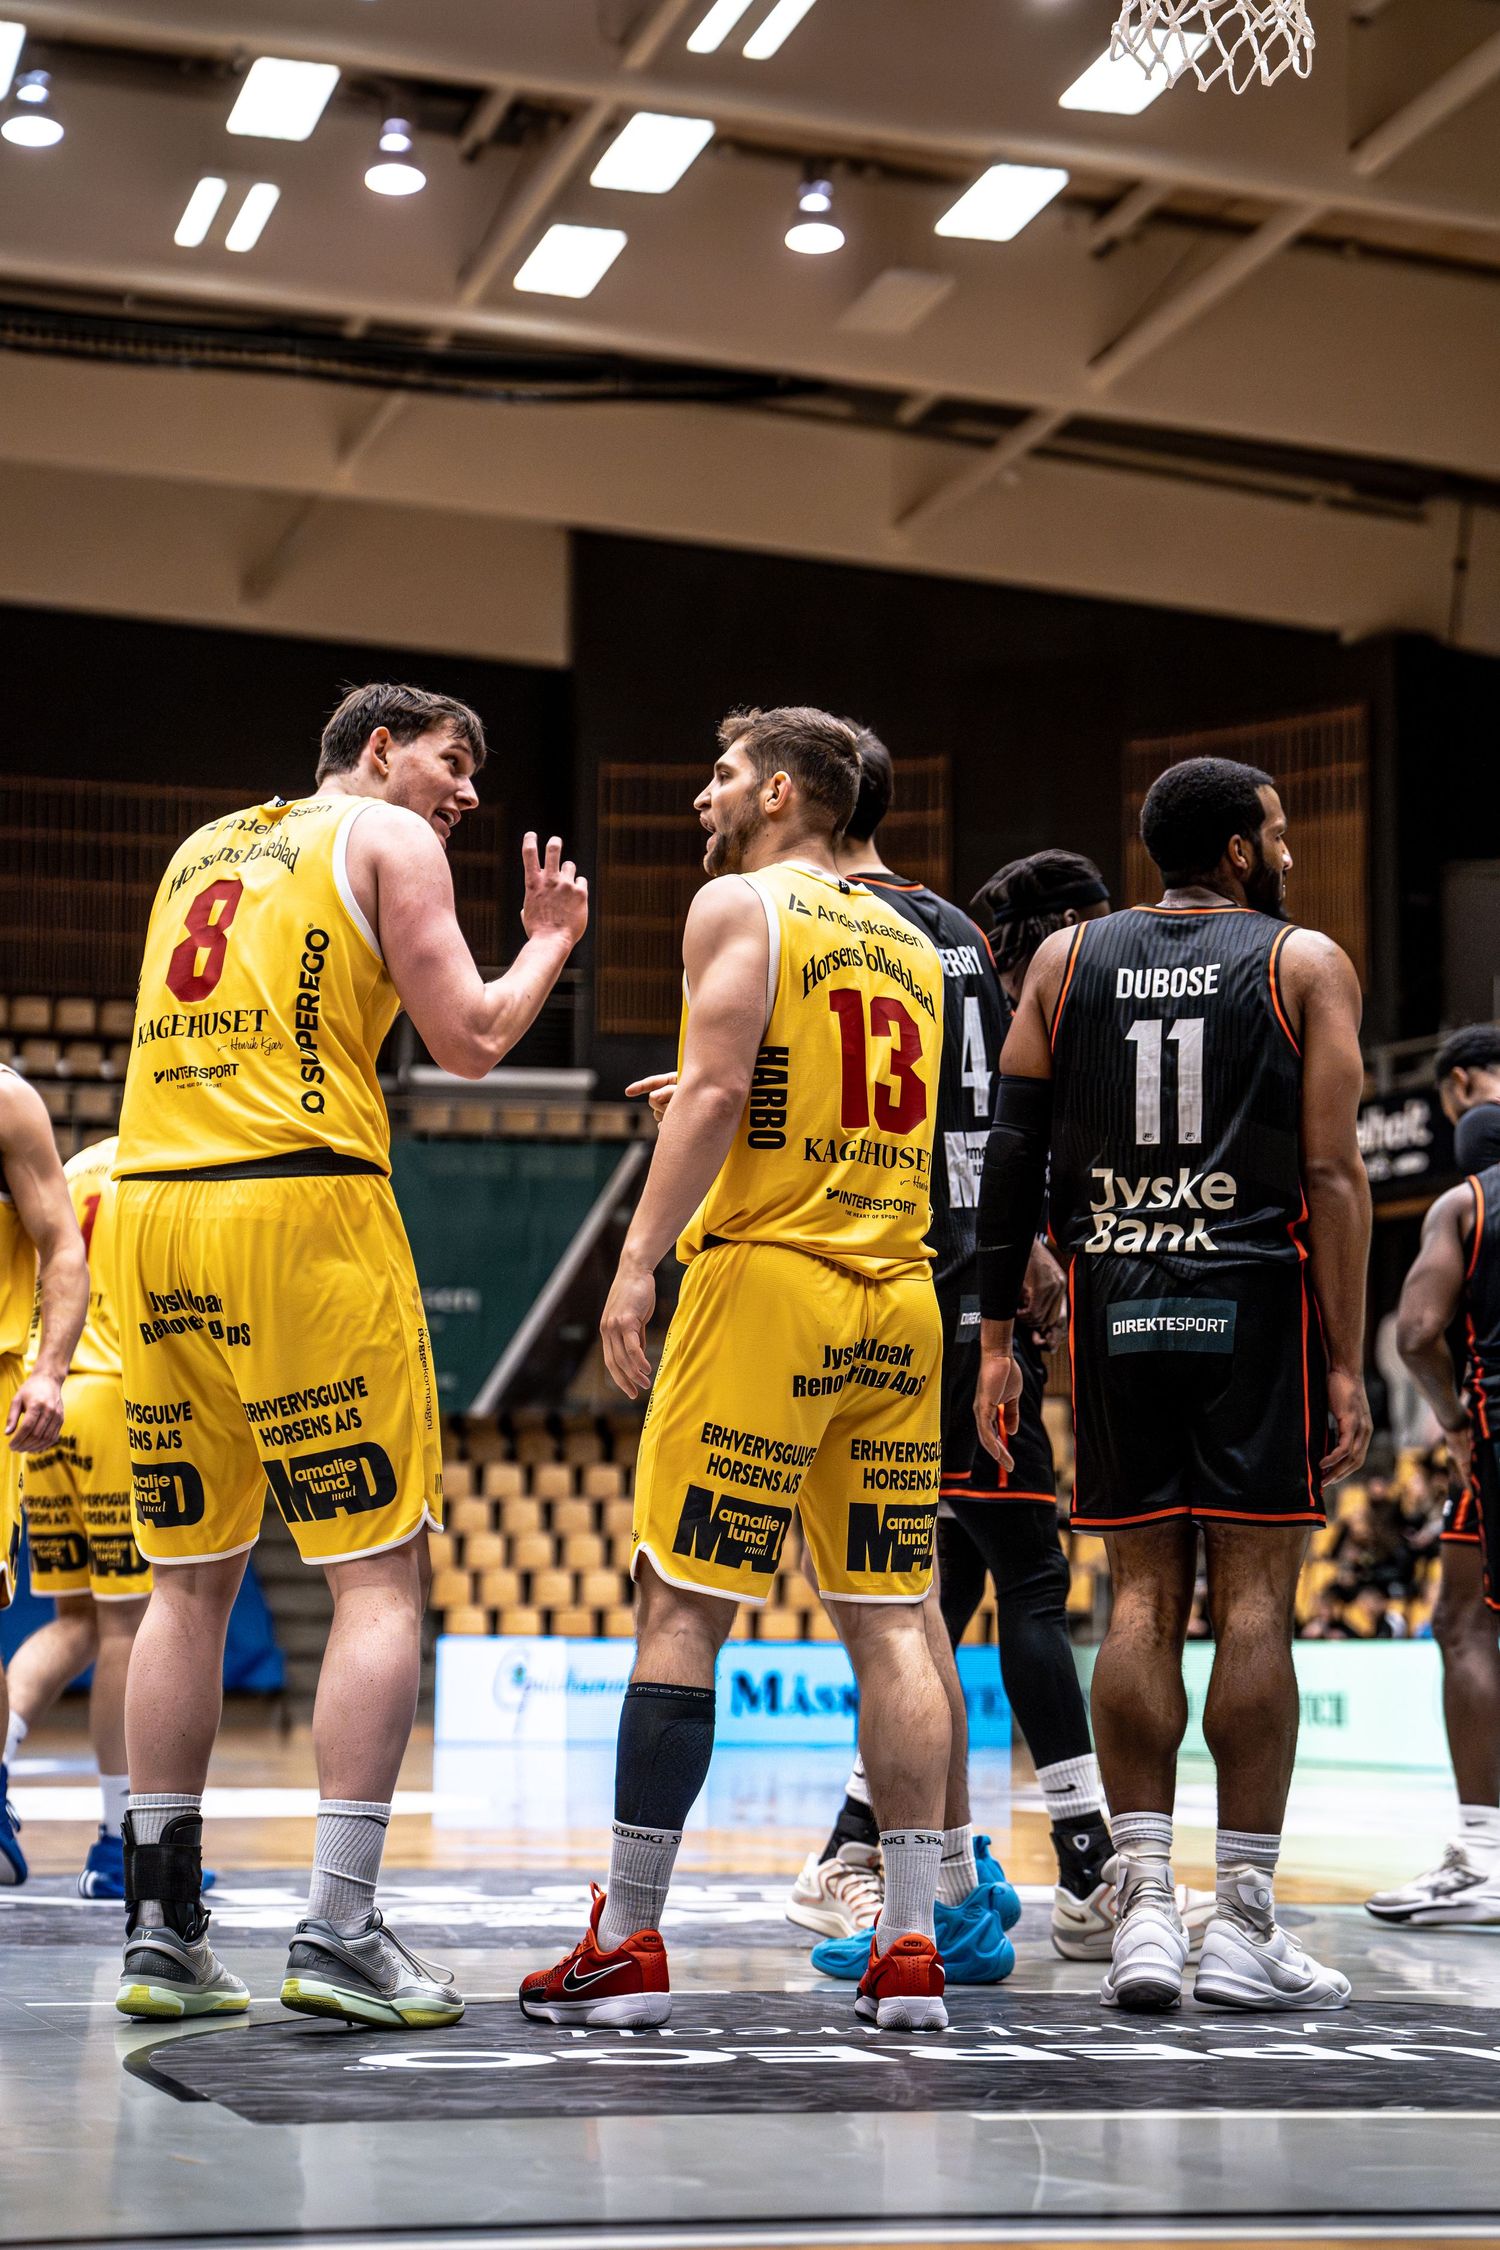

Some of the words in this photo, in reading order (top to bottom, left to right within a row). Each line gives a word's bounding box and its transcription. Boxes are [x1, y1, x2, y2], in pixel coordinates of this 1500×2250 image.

[165, 878, 244, 1003] 8
[801, 946, 864, 1000] Horsens
[937, 944, 984, 977] ERRY
[1115, 963, 1221, 999] DUBOSE
[296, 928, 330, 1084] SUPEREGO
[137, 1009, 269, 1048] KAGEHUSET
[165, 1063, 240, 1082] INTERSPORT
[828, 987, 928, 1136] 13
[961, 996, 993, 1117] 4
[747, 1046, 790, 1150] HARBO
[1124, 1017, 1205, 1145] 11
[838, 1190, 917, 1215] INTERSPORT
[1089, 1168, 1237, 1213] Jyske
[1085, 1212, 1220, 1253] Bank
[1112, 1316, 1229, 1336] DIREKTESPORT
[259, 1414, 332, 1447] HORSENS
[336, 1407, 362, 1433] A/S
[294, 1459, 358, 1482] amalie
[308, 1473, 351, 1495] lund
[706, 1452, 782, 1492] HORSENS
[781, 1472, 802, 1495] A/S
[863, 1467, 932, 1491] HORSENS
[718, 1508, 780, 1532] amalie
[727, 1523, 769, 1546] lund
